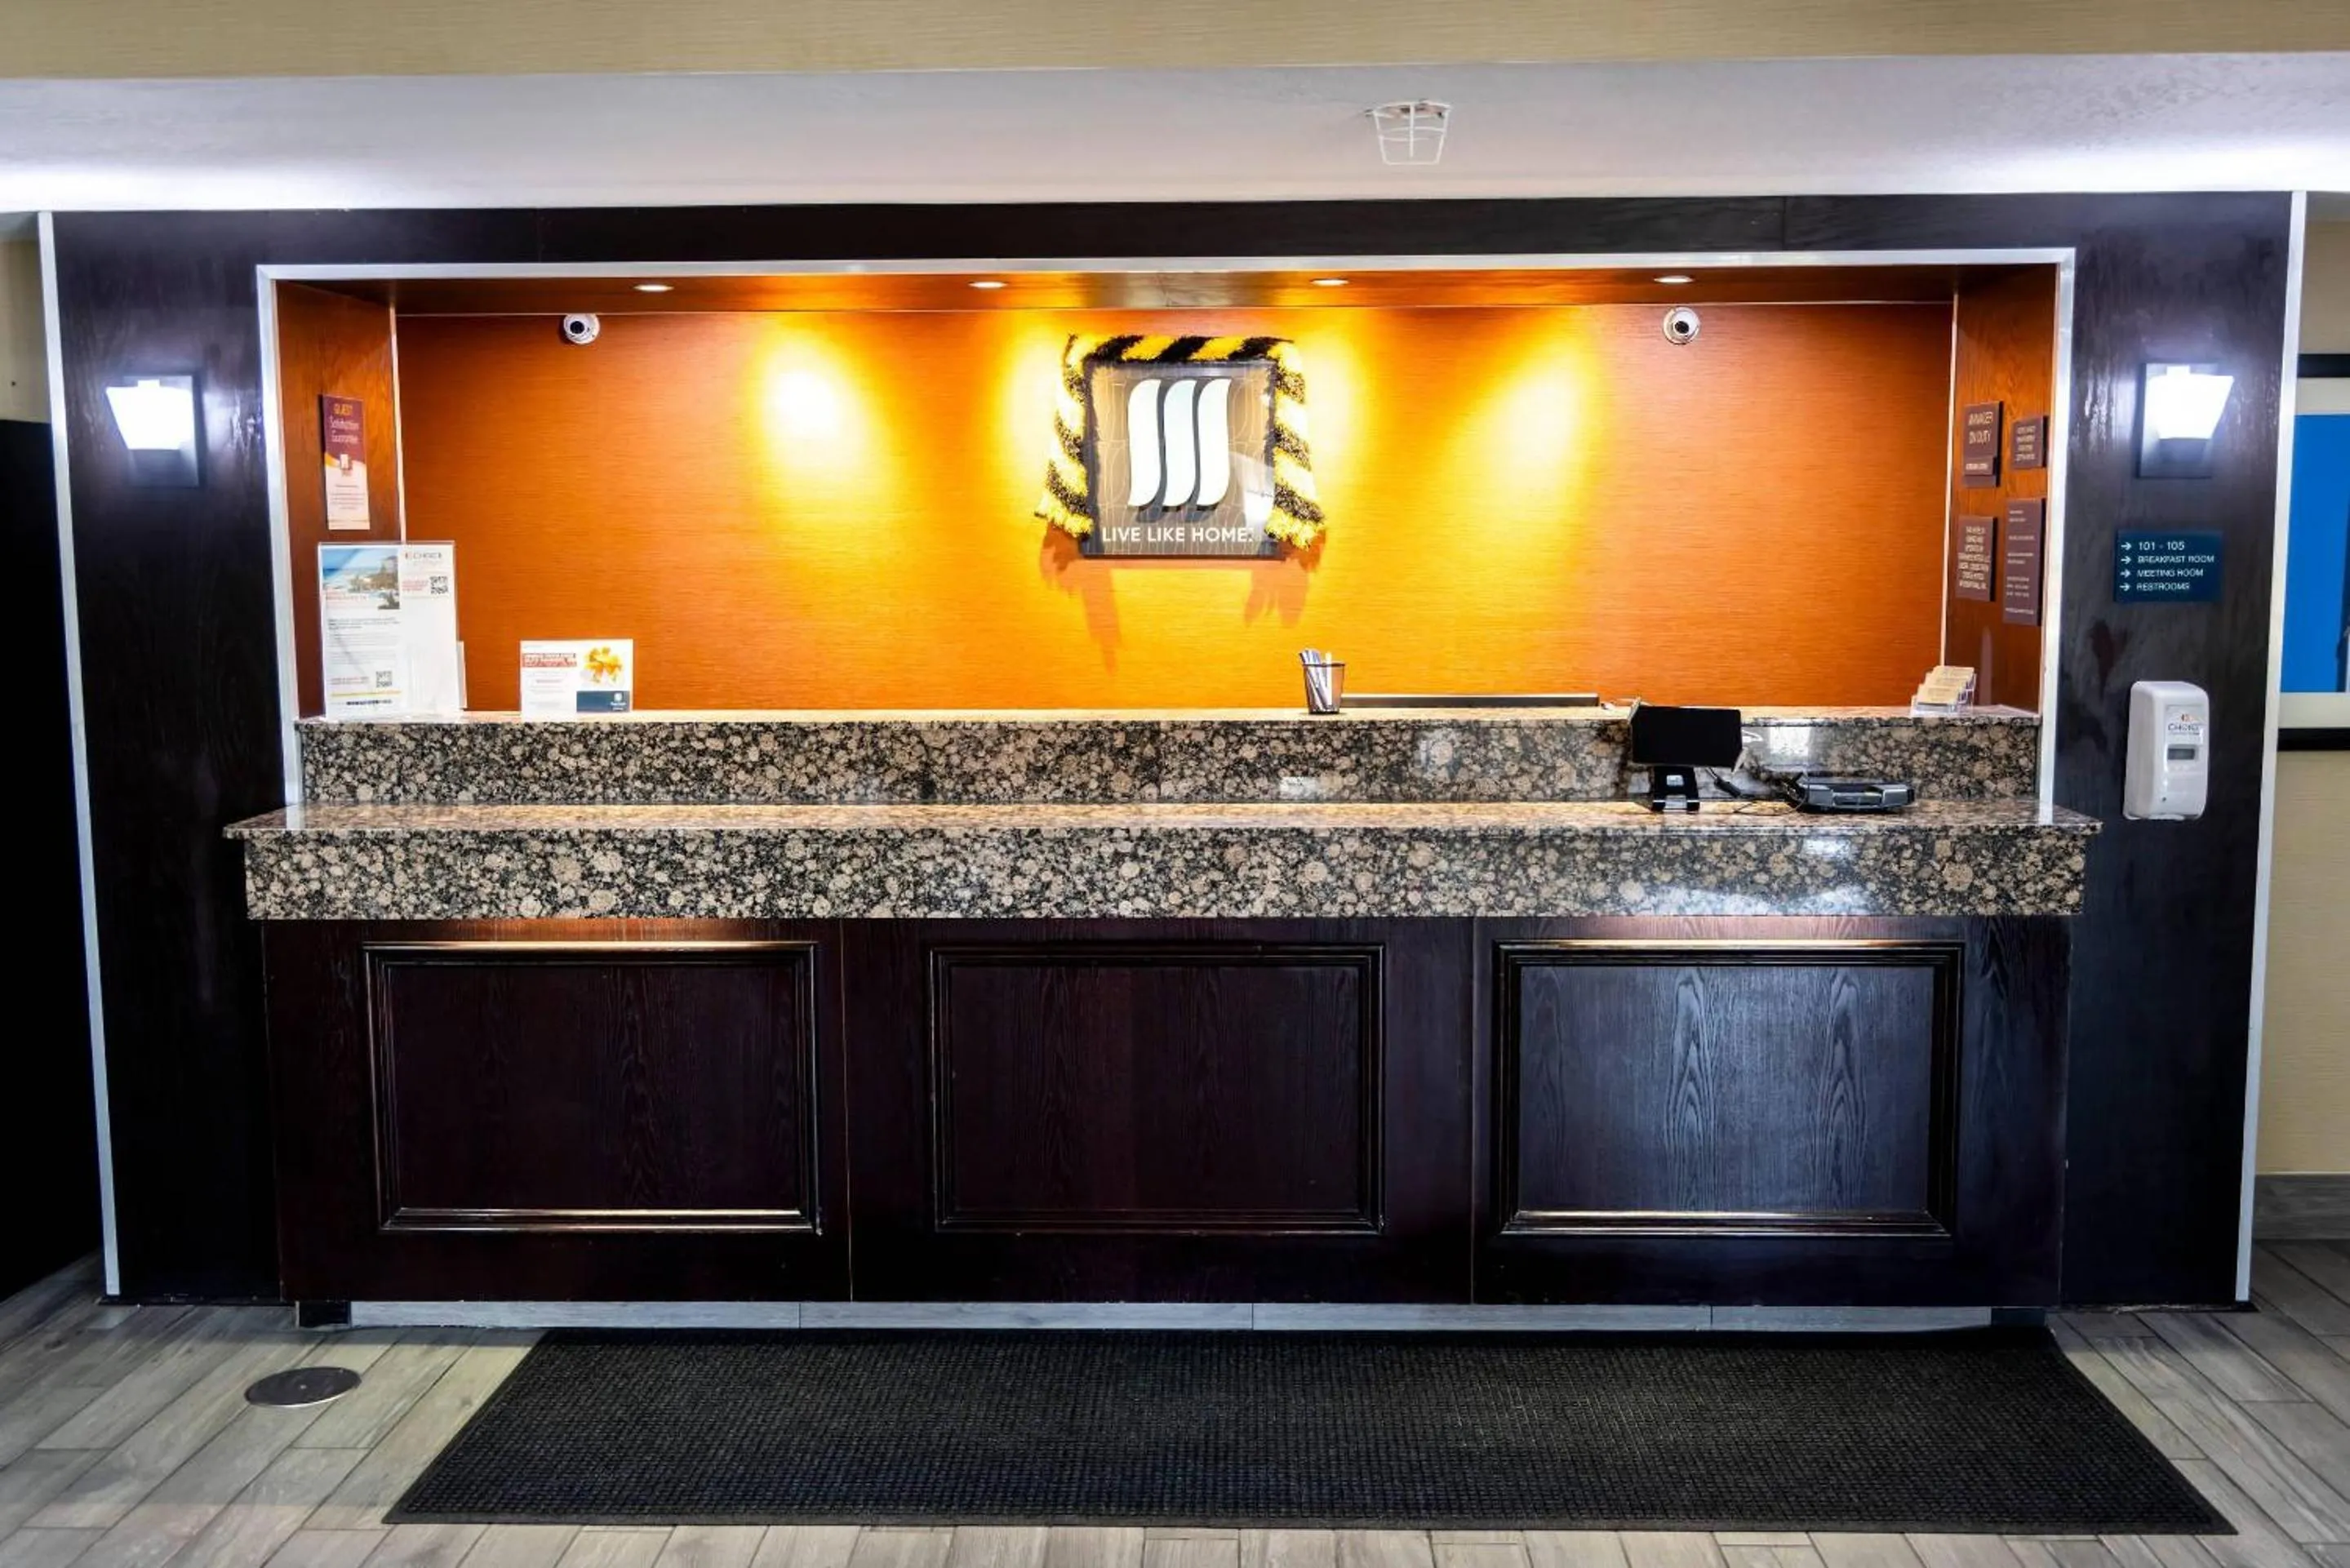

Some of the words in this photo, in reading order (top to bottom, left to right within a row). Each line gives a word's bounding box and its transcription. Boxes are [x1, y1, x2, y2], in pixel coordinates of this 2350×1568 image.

[1102, 526, 1141, 542] LIVE
[1147, 526, 1185, 542] LIKE
[2139, 541, 2155, 550] 101
[2167, 540, 2185, 550] 105
[2188, 555, 2215, 563] ROOM
[2177, 568, 2203, 577] ROOM
[2136, 582, 2190, 591] RESTROOMS
